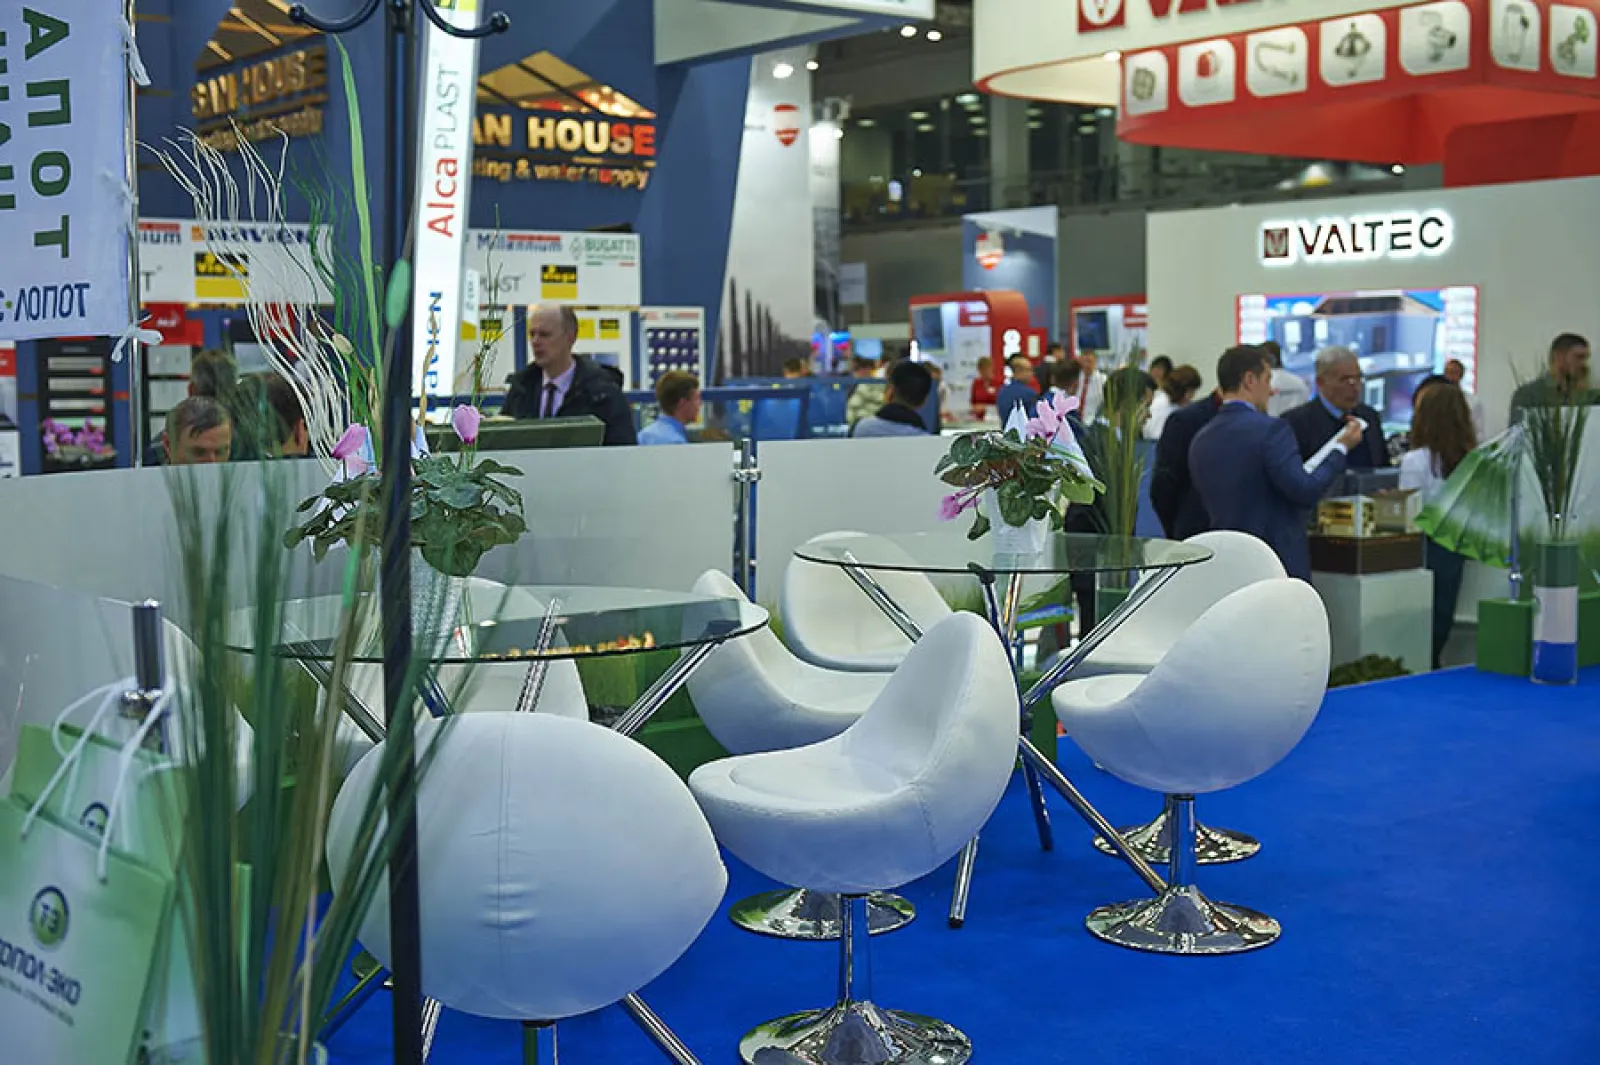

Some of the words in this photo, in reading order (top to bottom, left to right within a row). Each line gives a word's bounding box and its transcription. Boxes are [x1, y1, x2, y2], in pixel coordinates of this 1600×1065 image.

[434, 64, 460, 150] PLAST
[526, 116, 656, 156] HOUSE
[533, 163, 587, 182] water
[426, 157, 458, 238] Alca
[585, 238, 636, 252] BUGATTI
[1298, 216, 1445, 255] VALTEC
